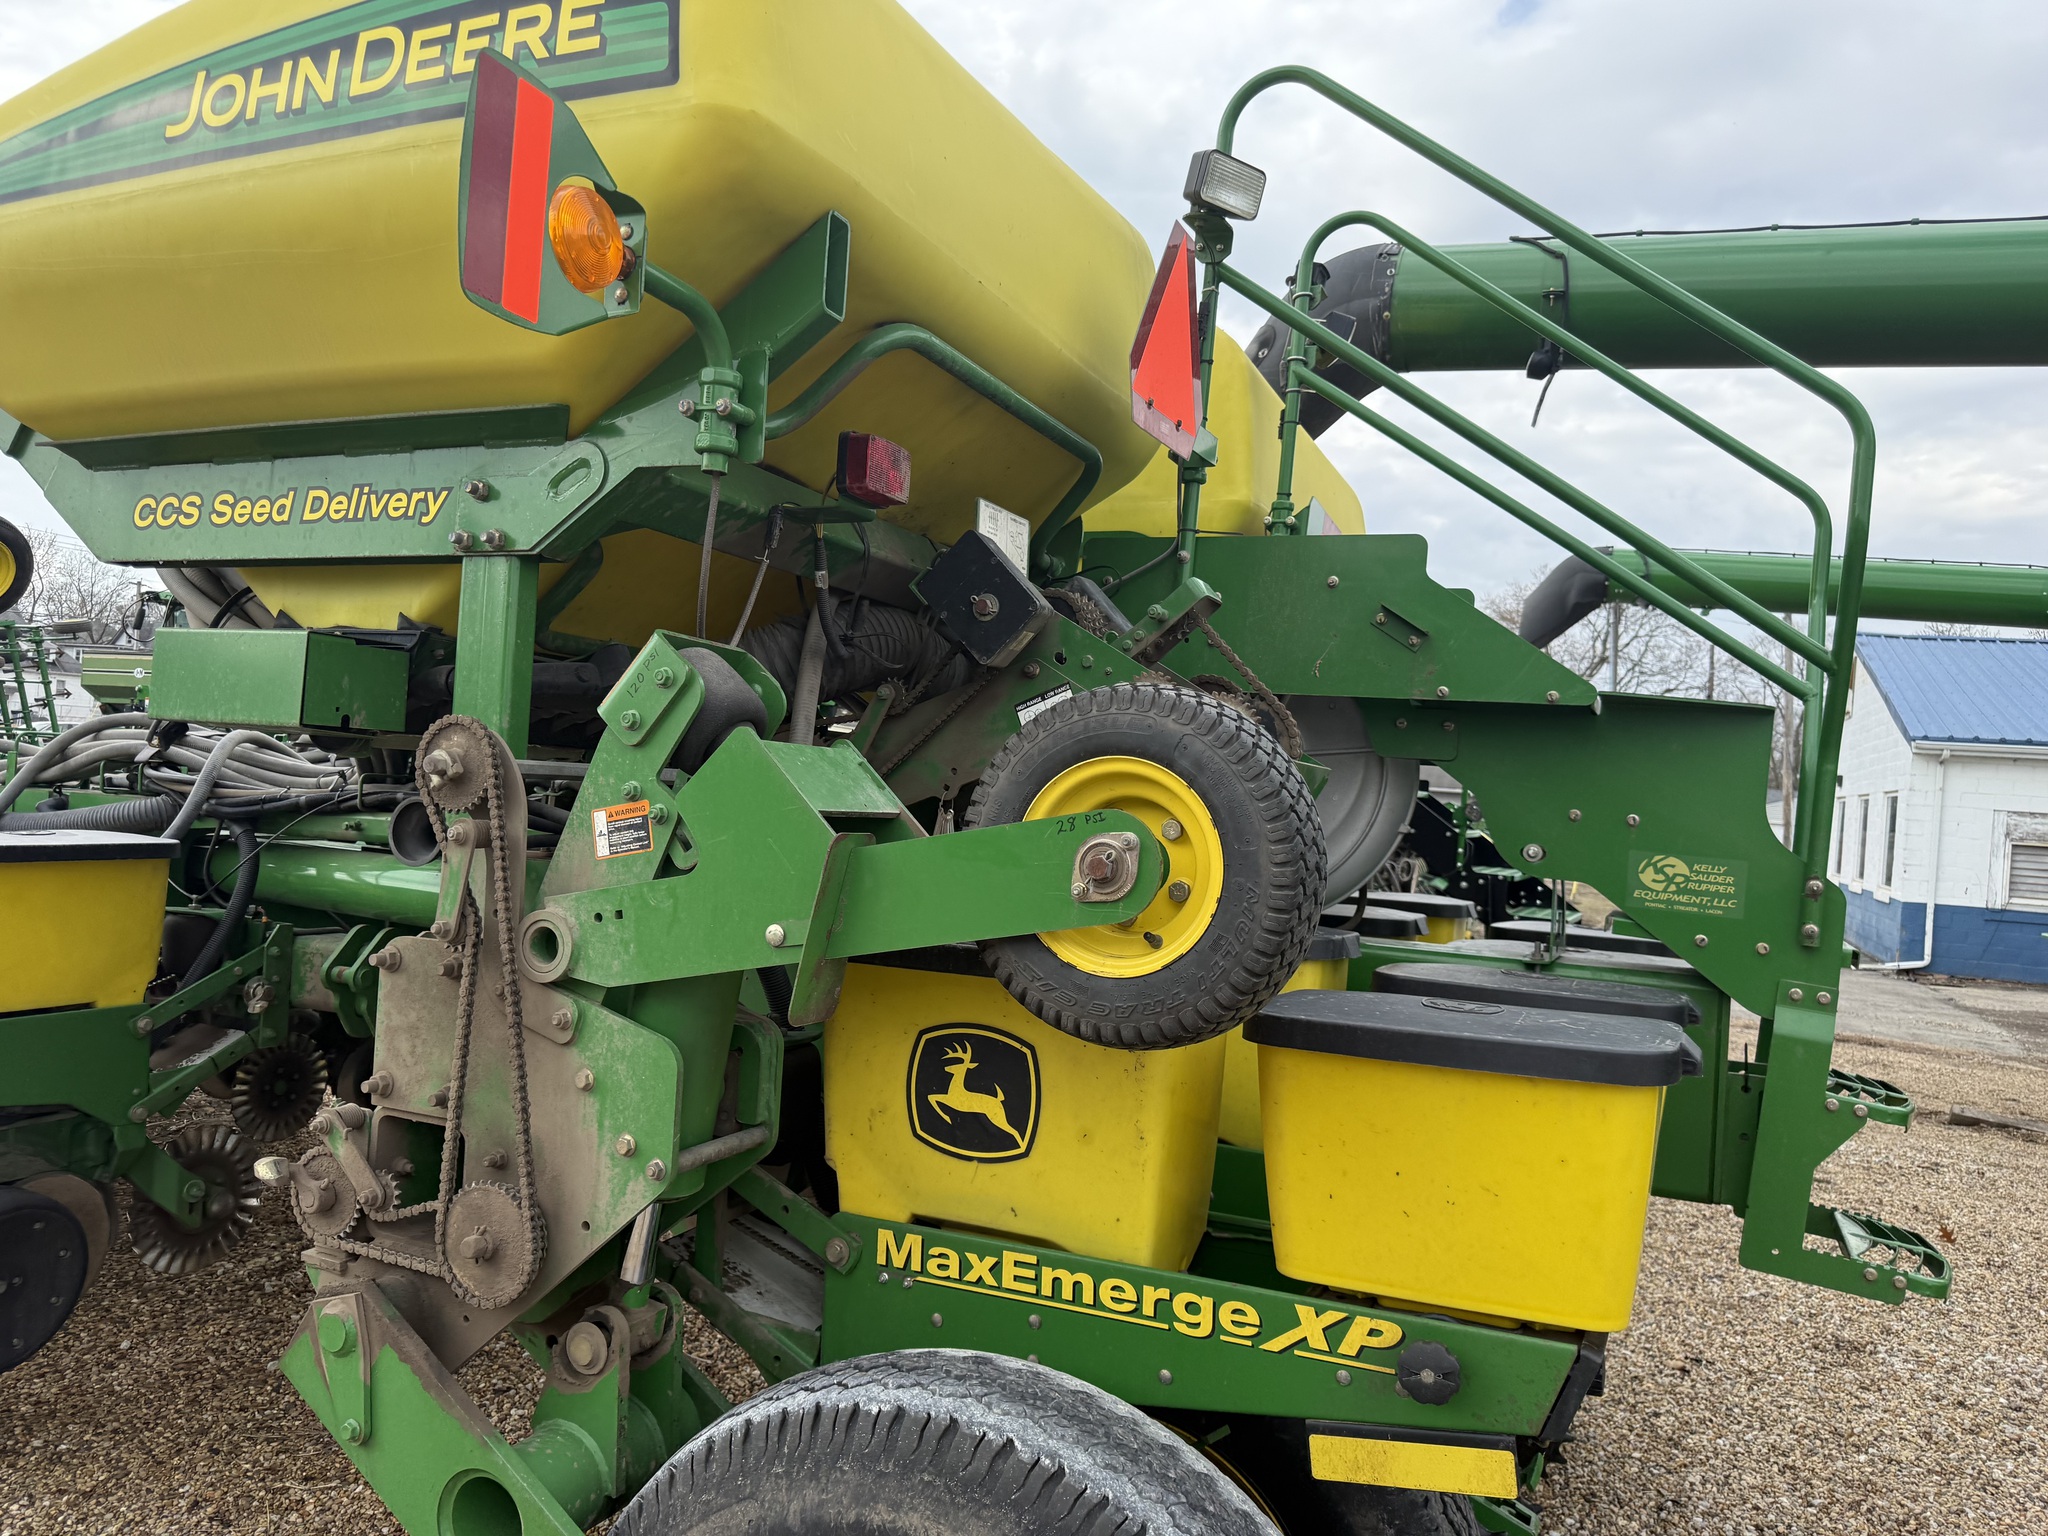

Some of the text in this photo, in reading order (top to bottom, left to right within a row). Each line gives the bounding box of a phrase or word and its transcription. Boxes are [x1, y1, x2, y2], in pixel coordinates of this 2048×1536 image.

[164, 0, 602, 138] JOHN DEERE
[133, 485, 449, 527] CCS Seed Delivery
[627, 672, 645, 698] 120
[1044, 684, 1071, 699] LOW RANGE
[1016, 696, 1042, 712] HIGH RANGE
[614, 805, 646, 817] WARNING
[1056, 811, 1107, 835] 28 PSI
[1692, 864, 1728, 873] KELLY
[1687, 882, 1736, 894] RUPIPER
[1689, 873, 1735, 884] SAUDER
[1633, 889, 1738, 908] EQUIPMENT, LLC
[1644, 901, 1667, 909] PONTIAC
[1197, 883, 1260, 992] MULTI
[1087, 988, 1186, 1019] TRAC
[876, 1227, 1403, 1357] MaxEmerge XP
